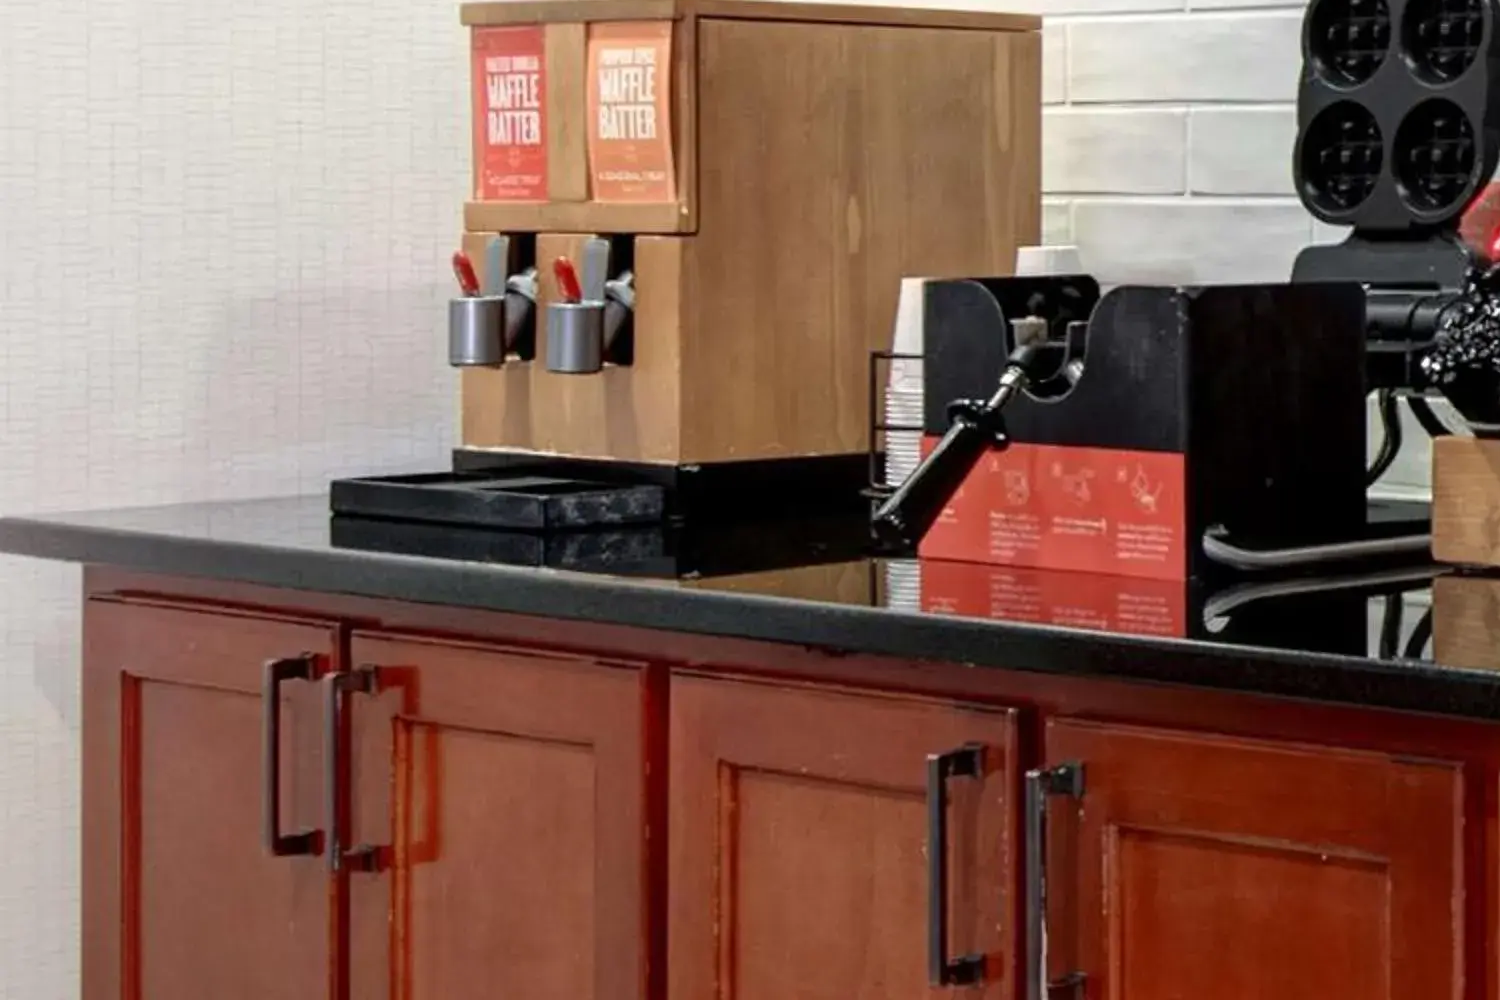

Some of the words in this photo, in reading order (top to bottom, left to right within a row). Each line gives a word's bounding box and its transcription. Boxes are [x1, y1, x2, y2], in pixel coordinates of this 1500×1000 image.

[486, 72, 541, 110] WAFFLE
[597, 66, 656, 102] WAFFLE
[488, 110, 542, 146] BATTER
[598, 103, 657, 140] BATTER
